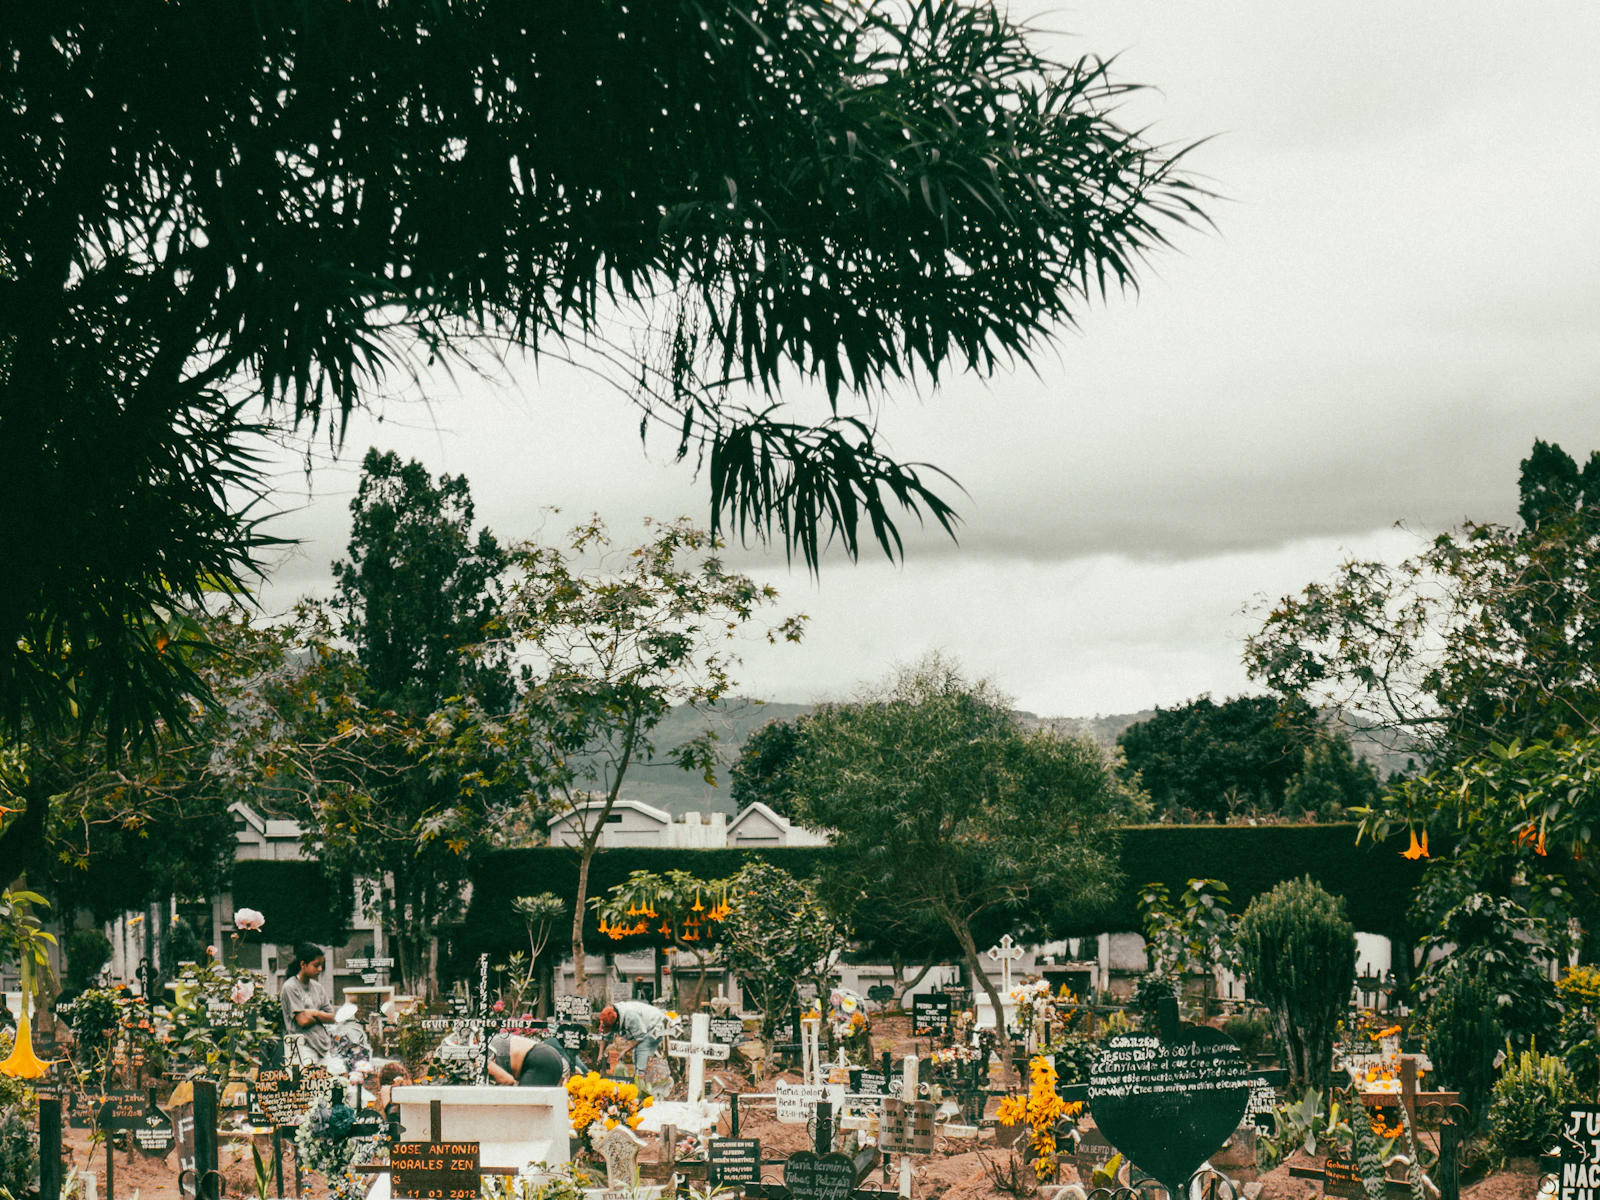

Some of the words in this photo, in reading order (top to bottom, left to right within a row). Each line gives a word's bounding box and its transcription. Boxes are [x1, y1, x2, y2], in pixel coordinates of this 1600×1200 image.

[801, 1087, 831, 1097] Dolors
[392, 1144, 421, 1155] JOSE
[429, 1144, 478, 1155] ANTONIO
[391, 1159, 444, 1170] MORALES
[450, 1159, 474, 1171] ZEN
[428, 1190, 443, 1198] 03
